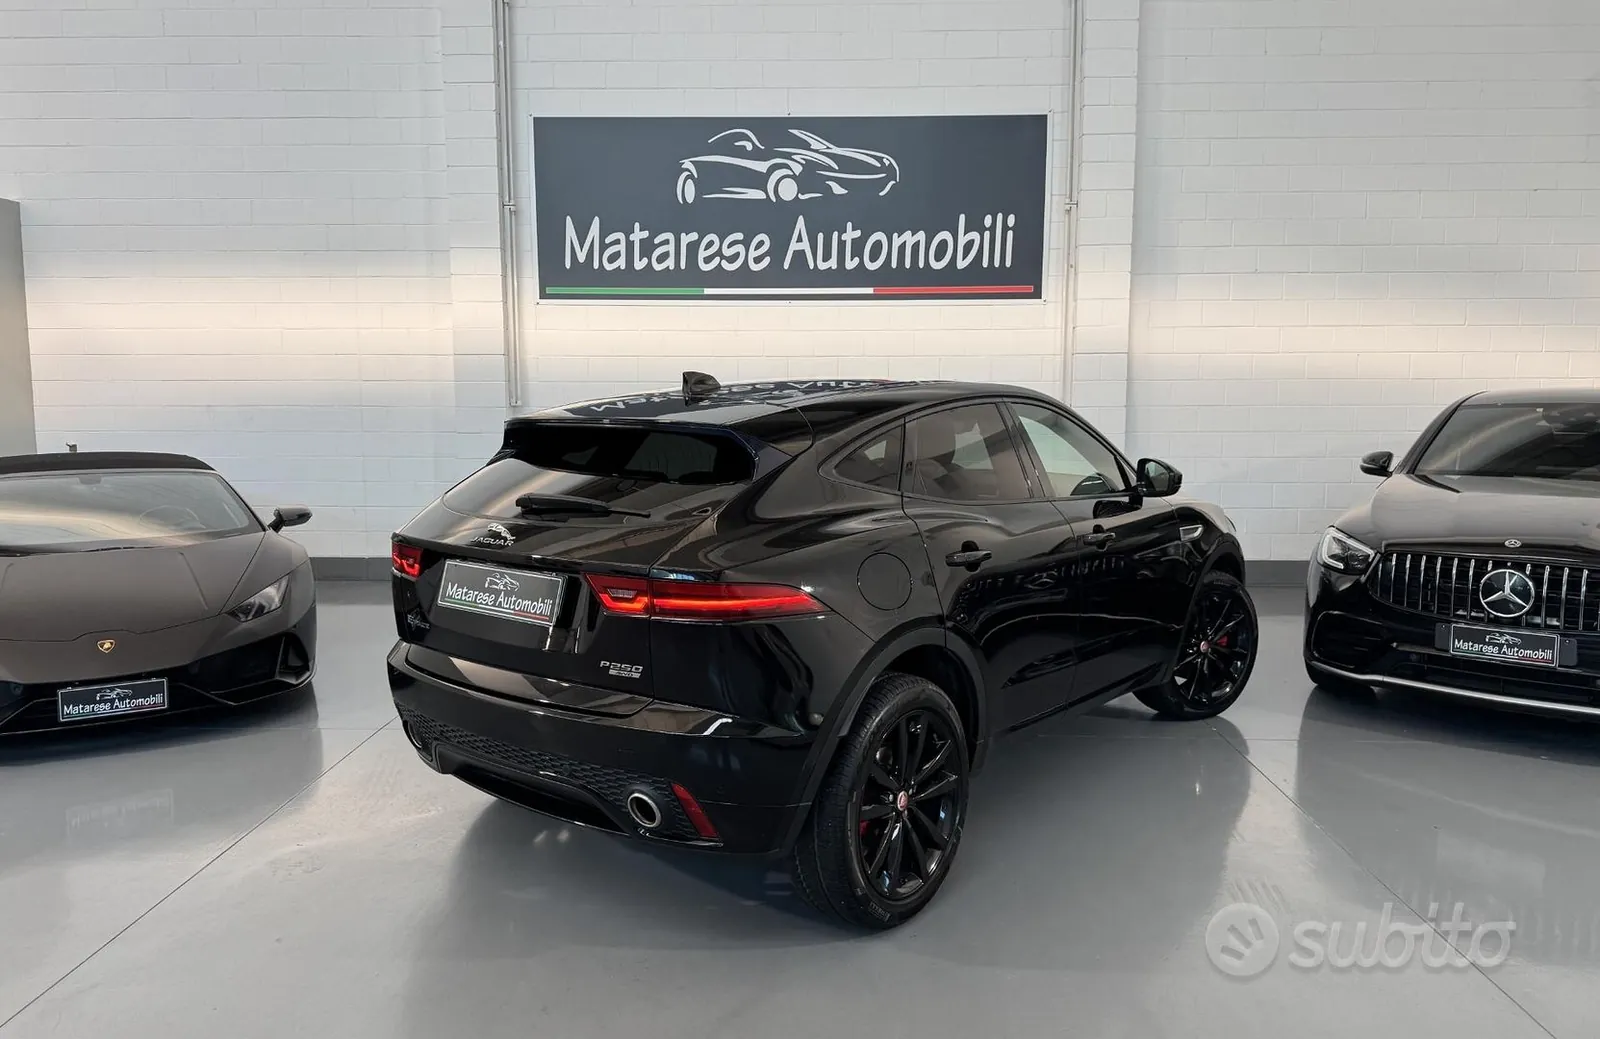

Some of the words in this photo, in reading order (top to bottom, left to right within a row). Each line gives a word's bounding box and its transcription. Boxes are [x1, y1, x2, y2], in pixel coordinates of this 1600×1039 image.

[564, 214, 772, 272] Matarese
[783, 212, 1016, 272] Automobili
[471, 536, 515, 546] JAGUAR
[445, 582, 496, 606] Matarese
[496, 591, 553, 616] Automobili
[1454, 638, 1499, 654] Matarese
[1500, 644, 1553, 660] Automobili
[600, 660, 643, 673] P250
[63, 702, 111, 715] Matarese
[113, 693, 163, 709] Automobili
